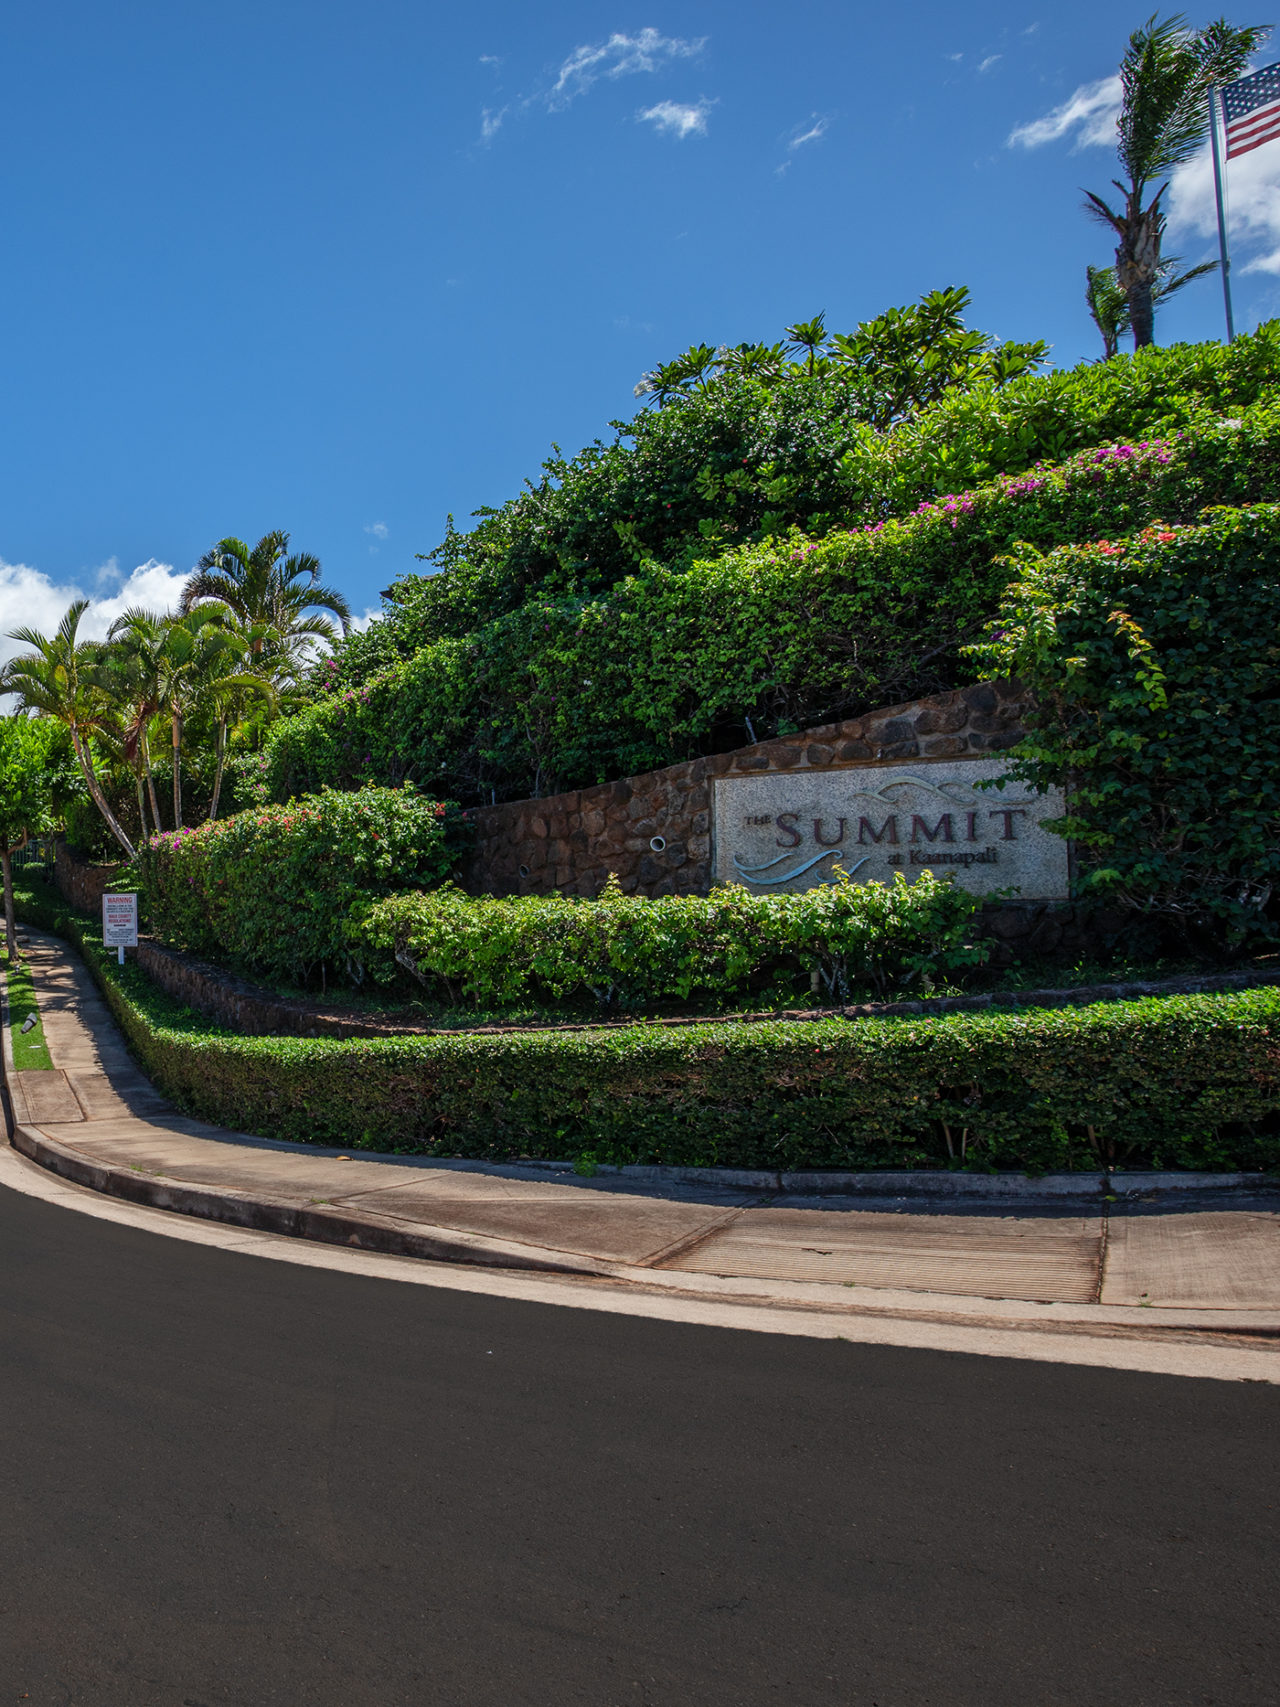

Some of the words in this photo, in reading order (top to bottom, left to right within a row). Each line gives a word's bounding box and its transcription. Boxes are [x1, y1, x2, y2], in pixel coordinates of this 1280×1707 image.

[744, 814, 772, 826] THE
[776, 810, 1027, 848] SUMMIT
[887, 852, 902, 865] at
[909, 846, 998, 869] Kaanapali
